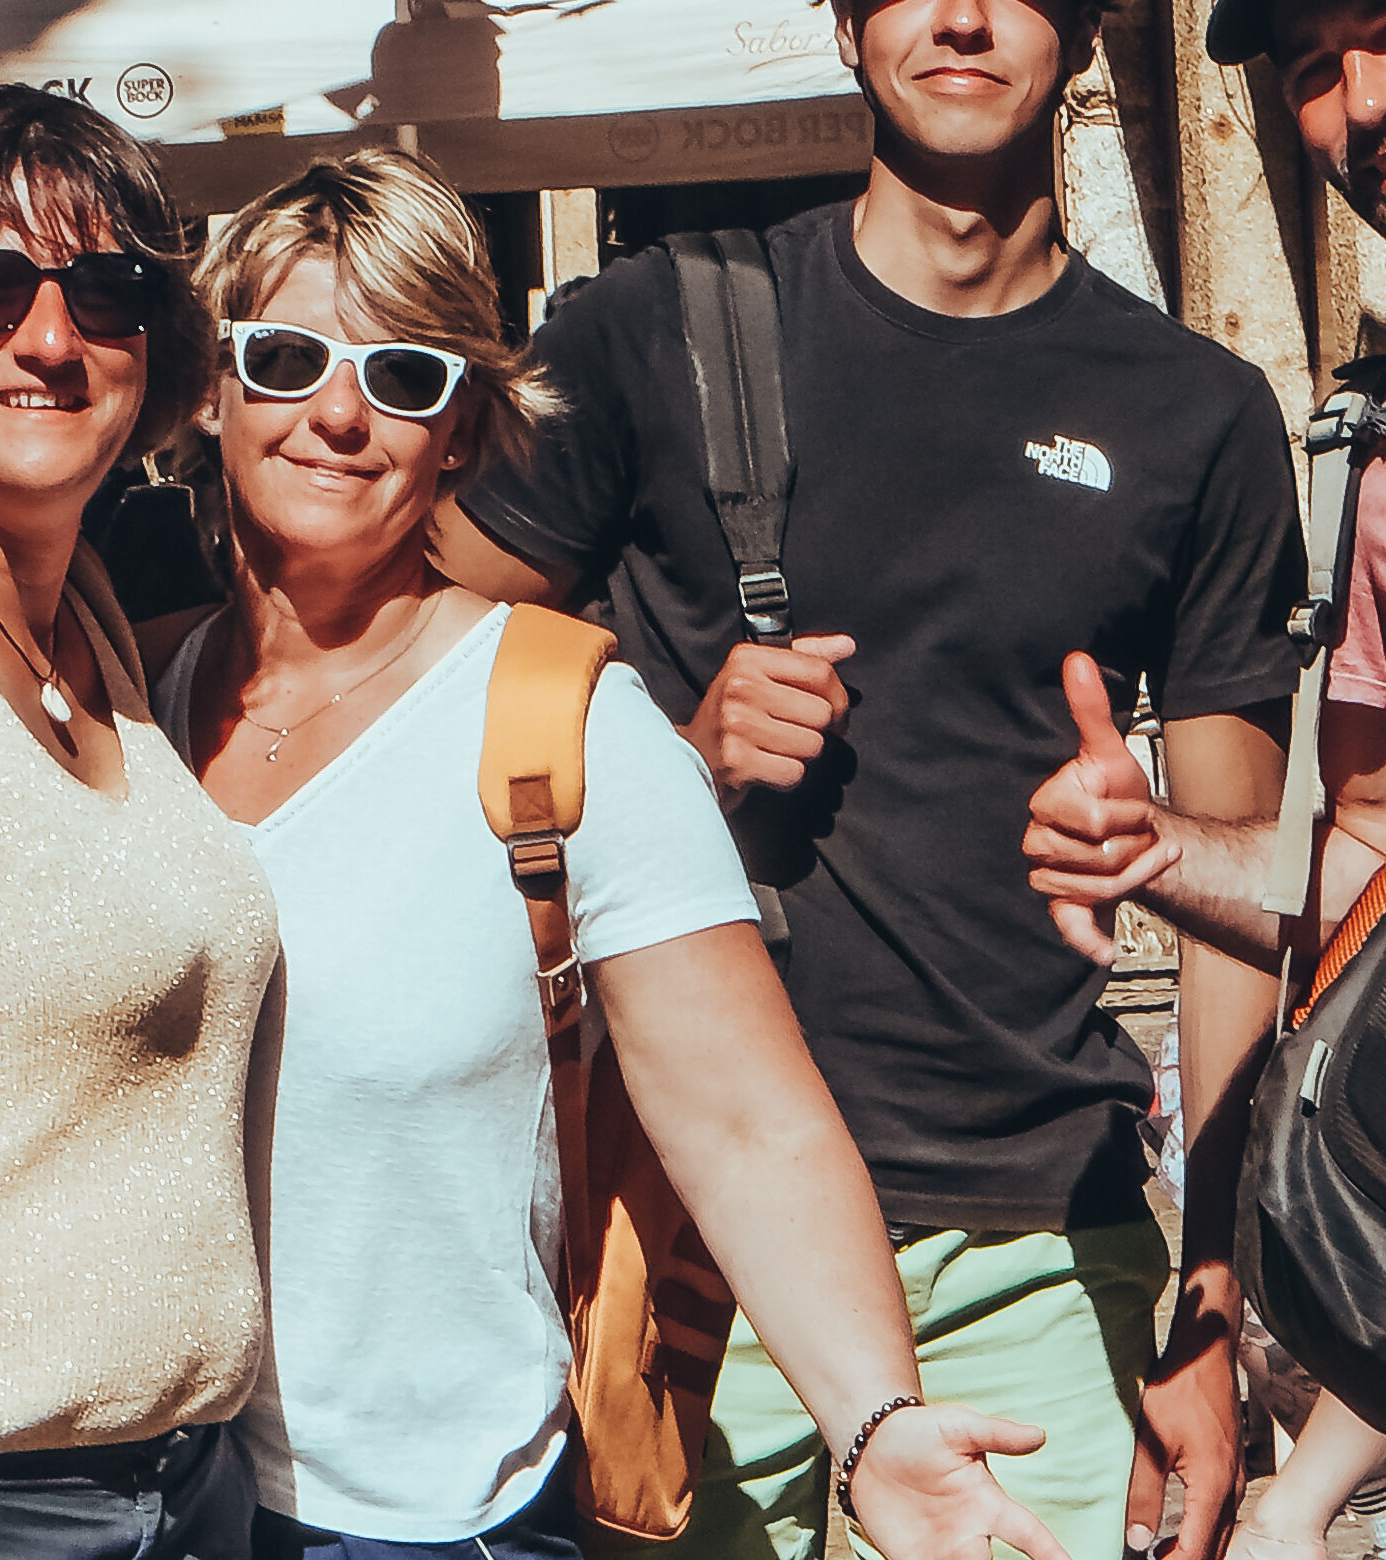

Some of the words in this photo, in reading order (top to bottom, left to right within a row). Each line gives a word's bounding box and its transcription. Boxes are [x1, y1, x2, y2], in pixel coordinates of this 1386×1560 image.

[726, 20, 820, 56] Sabor
[124, 78, 164, 92] SUPER
[126, 91, 164, 103] BOCK
[1054, 435, 1085, 455] THE
[1038, 461, 1080, 482] FACE
